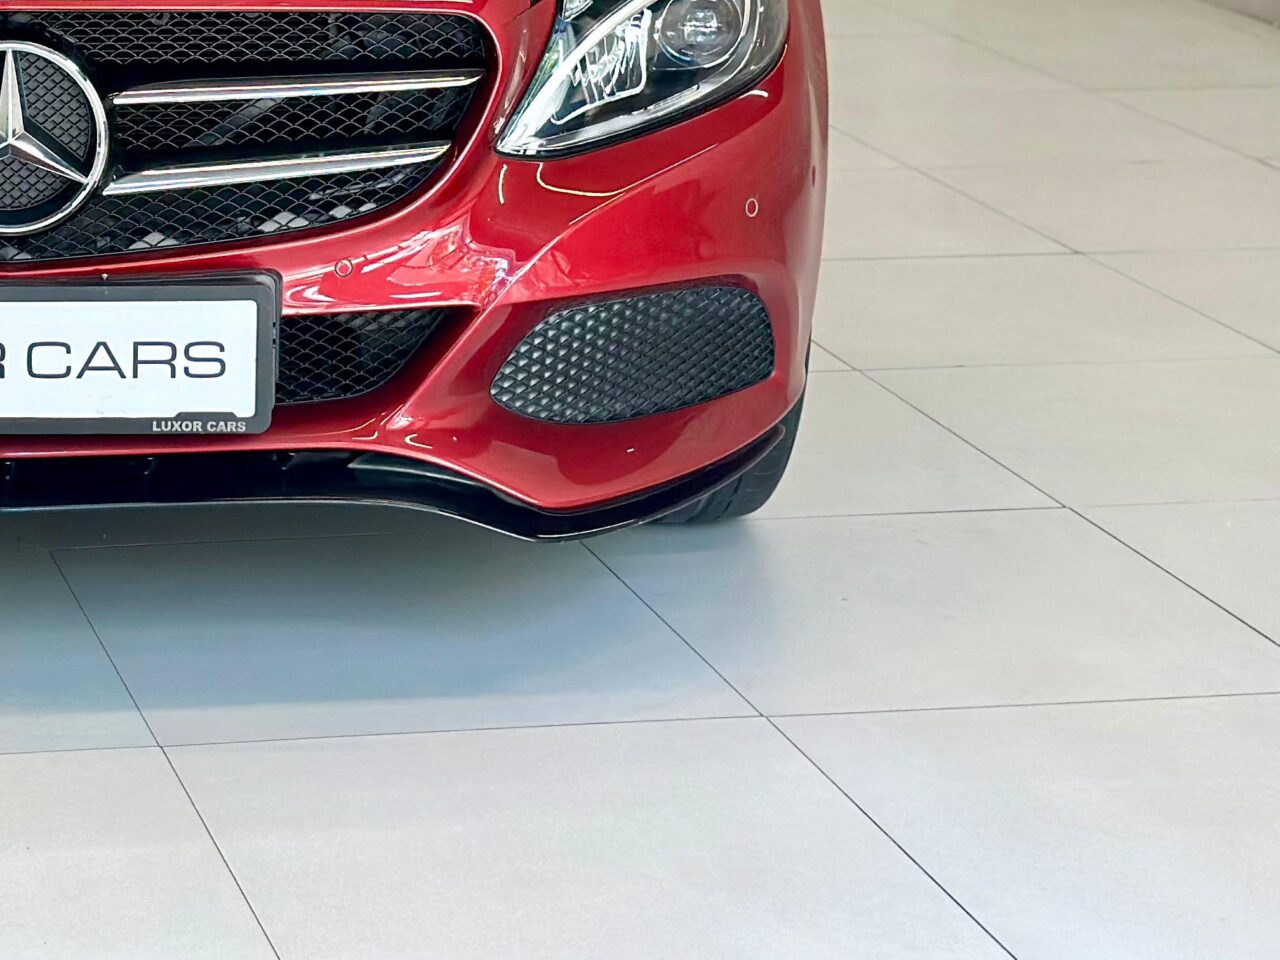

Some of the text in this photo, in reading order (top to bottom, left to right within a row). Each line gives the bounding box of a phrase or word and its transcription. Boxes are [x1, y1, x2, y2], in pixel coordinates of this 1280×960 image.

[25, 340, 227, 379] CARS
[152, 420, 247, 433] LUXOR CARS
